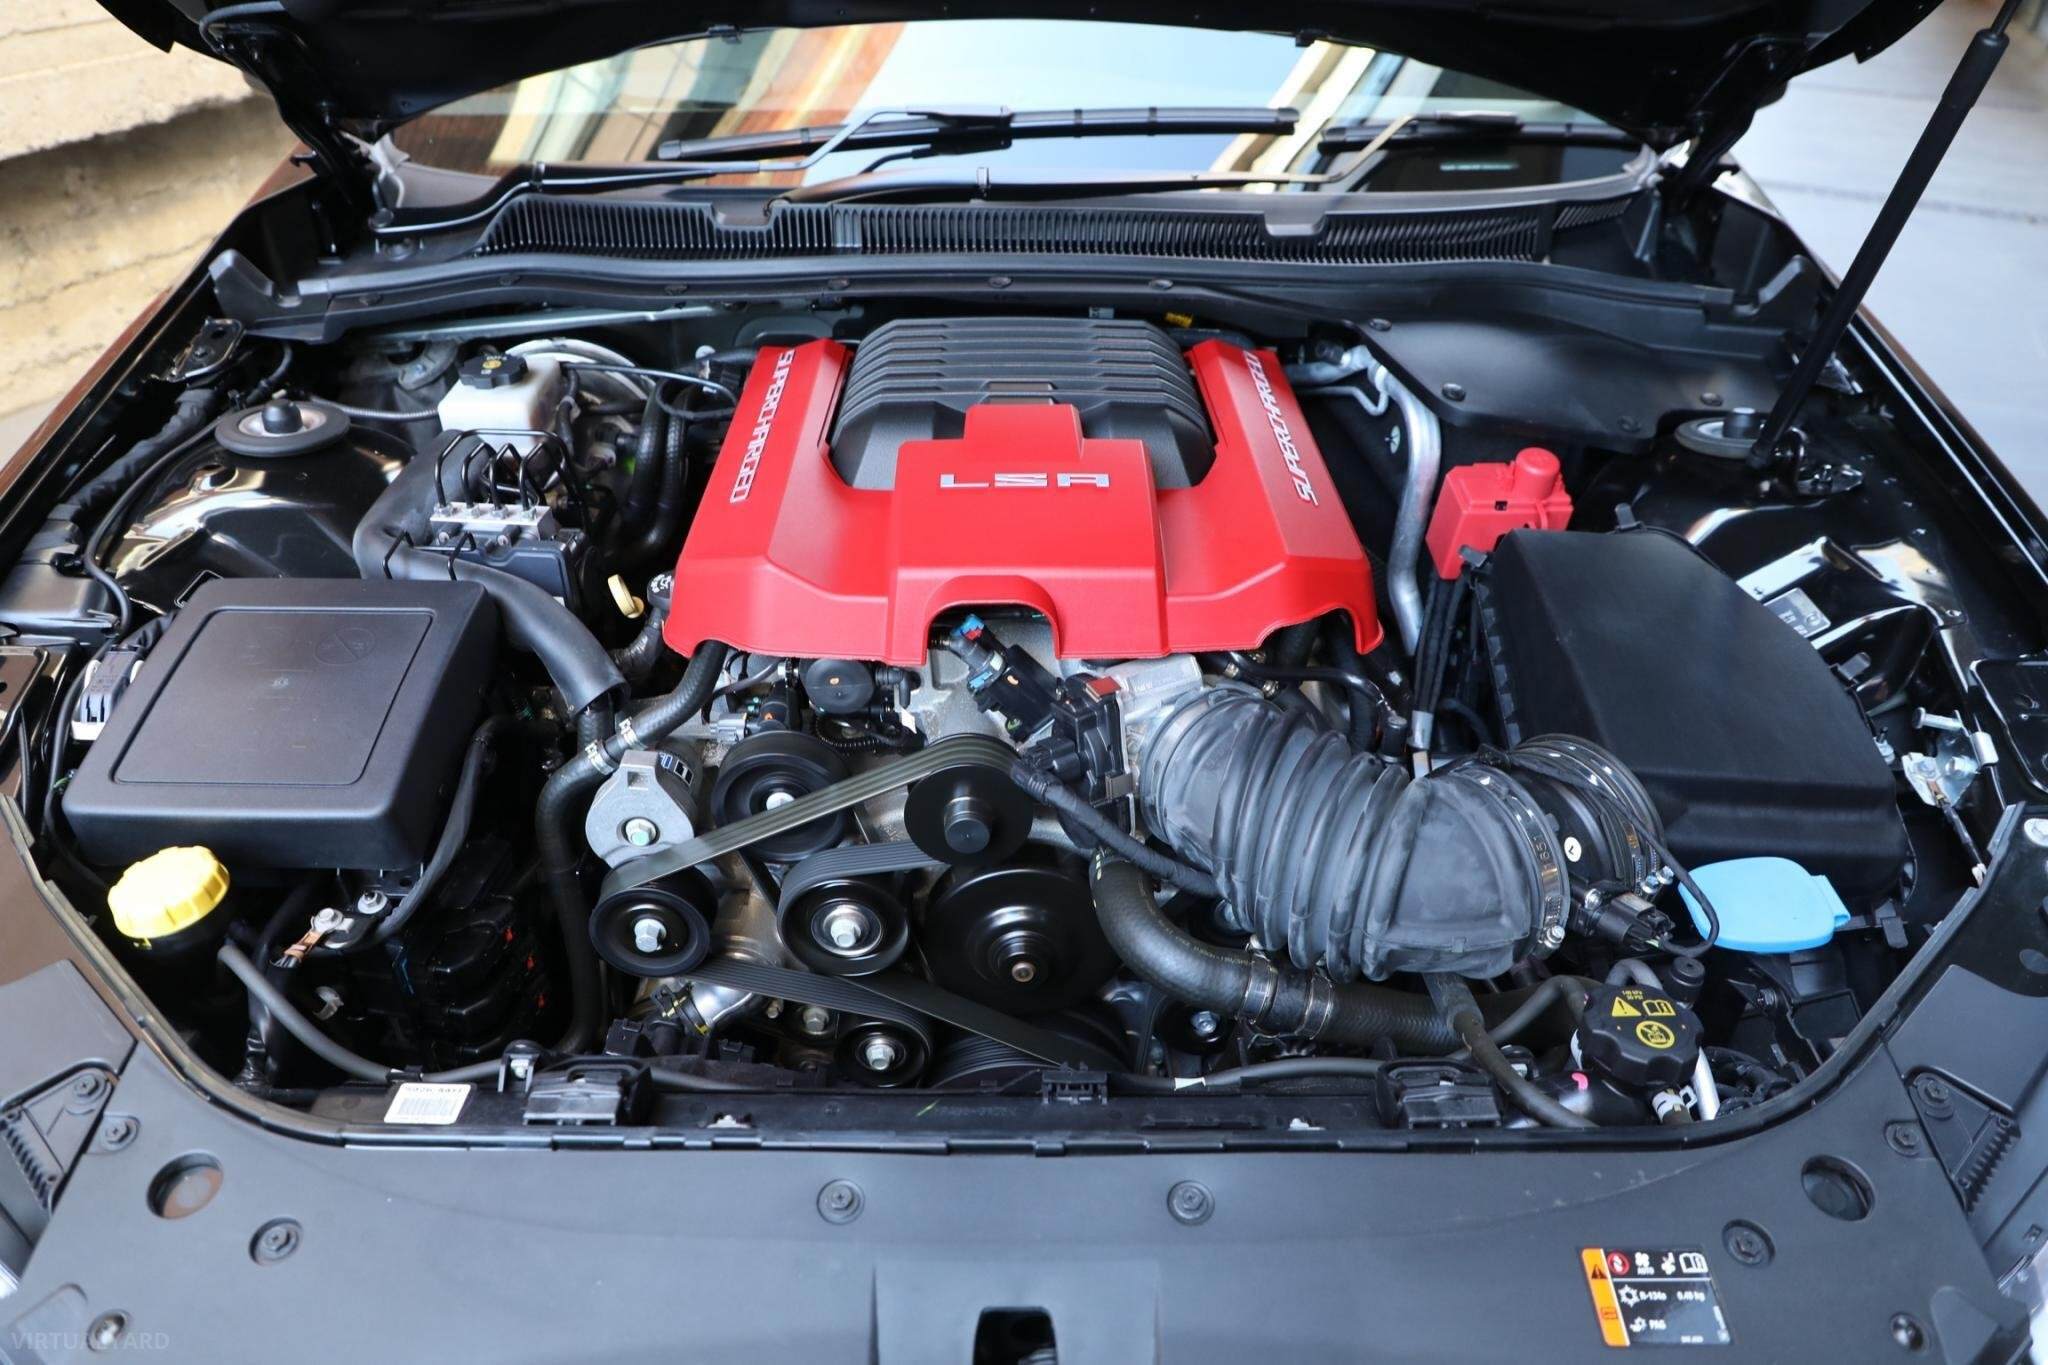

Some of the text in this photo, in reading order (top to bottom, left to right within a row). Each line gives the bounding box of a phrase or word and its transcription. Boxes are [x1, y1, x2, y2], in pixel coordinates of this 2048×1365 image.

[730, 349, 795, 503] SUPERCHARGED
[940, 473, 1110, 488] LSA
[1243, 351, 1319, 506] SUPERCHARGED
